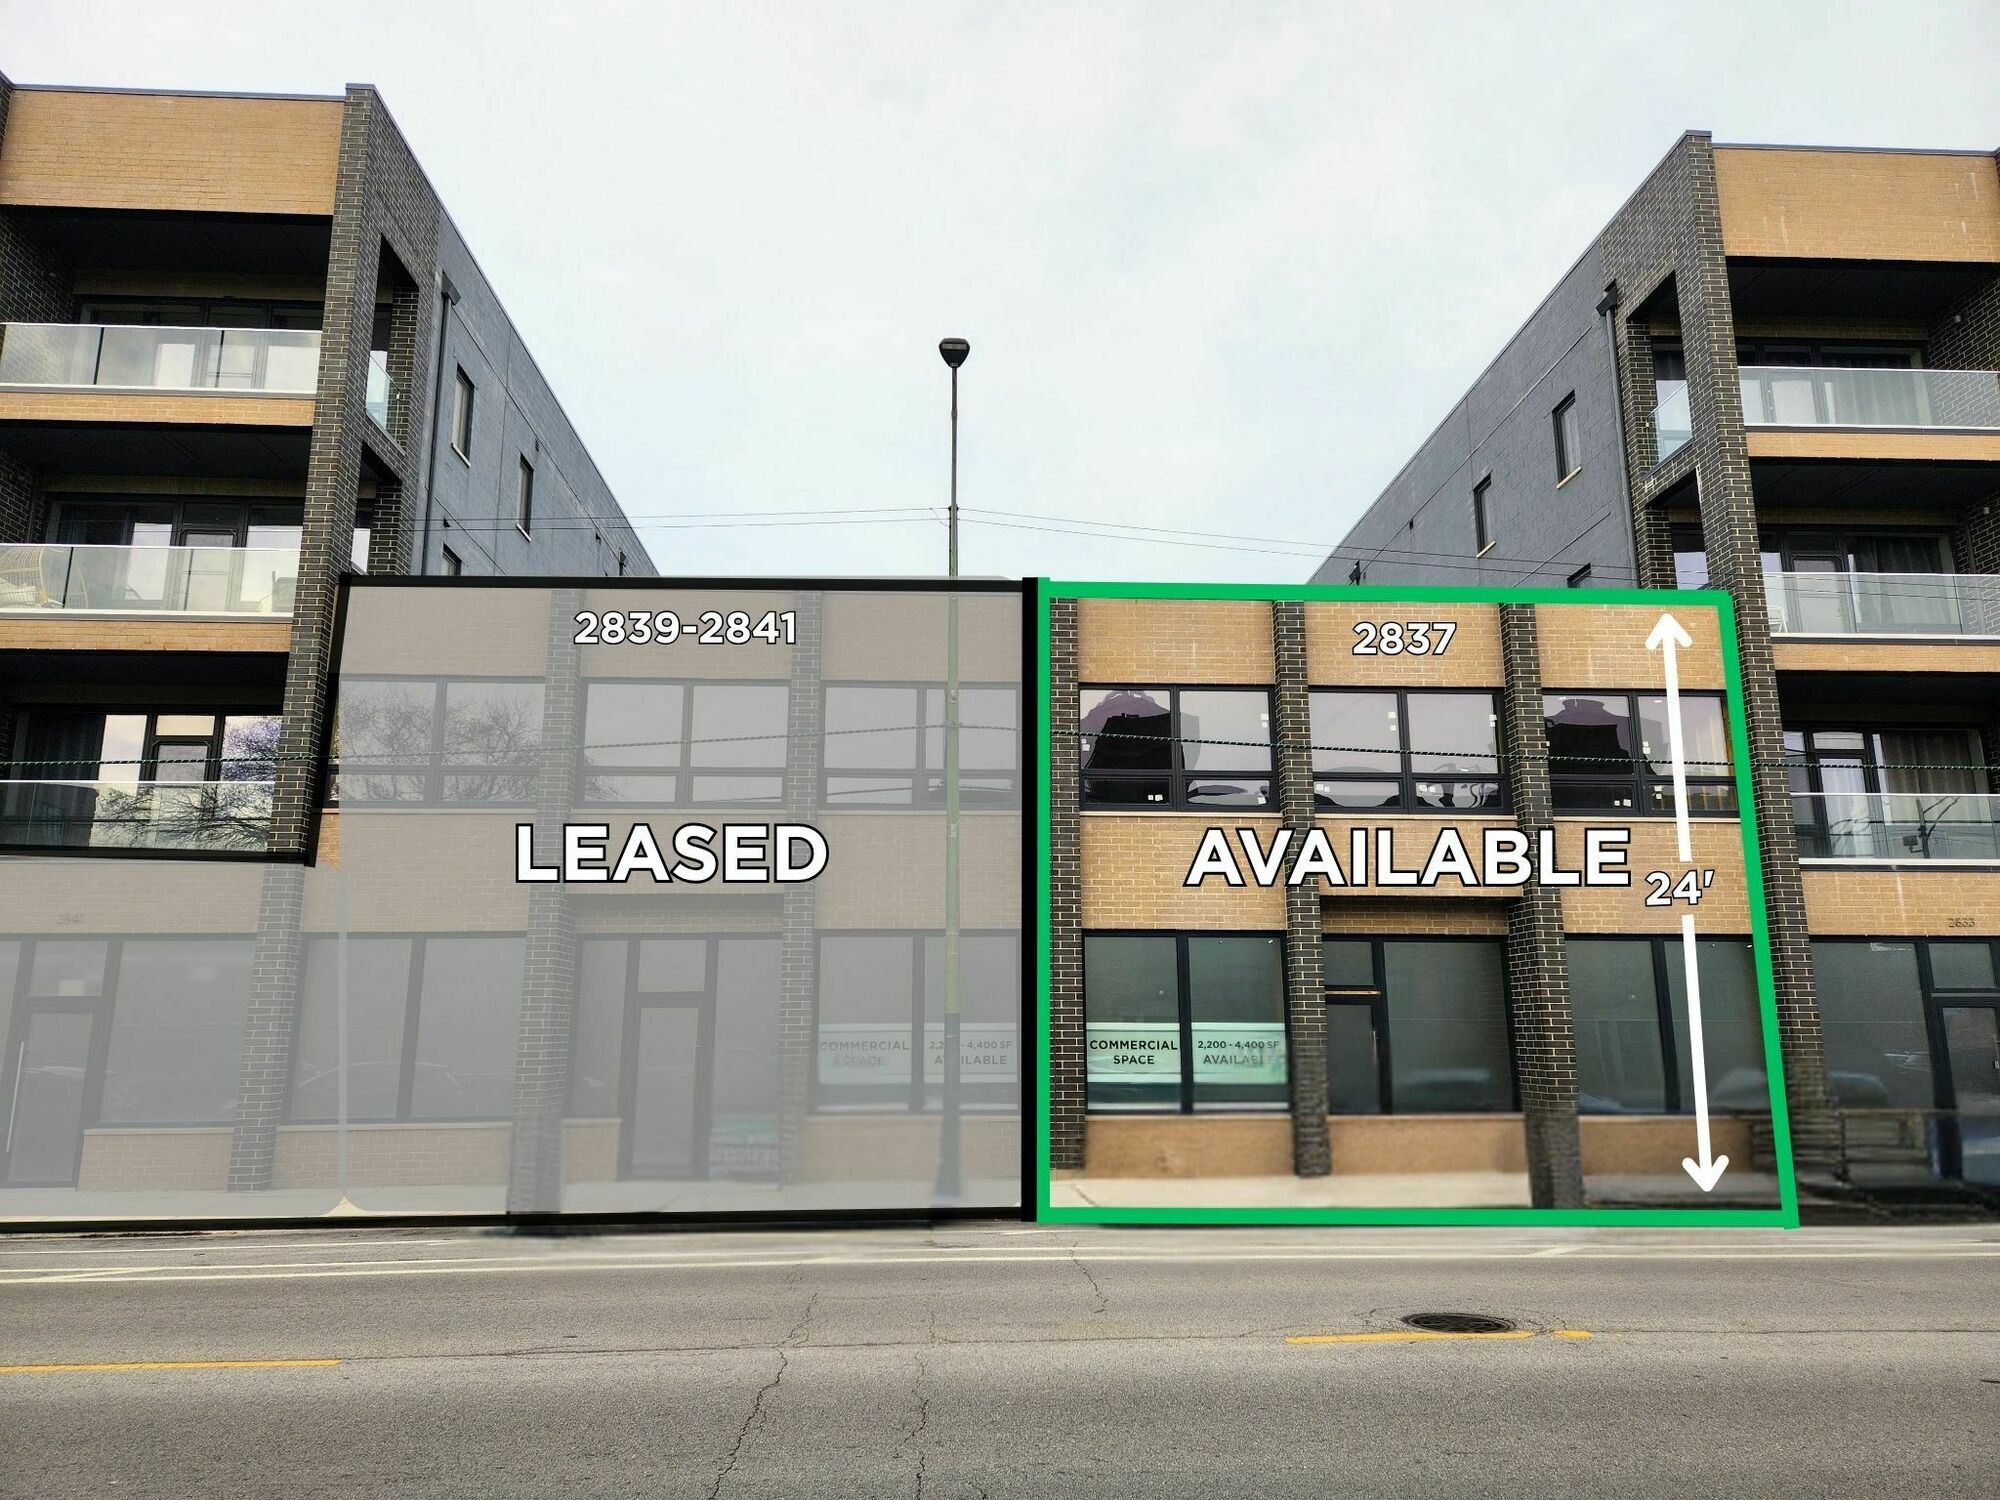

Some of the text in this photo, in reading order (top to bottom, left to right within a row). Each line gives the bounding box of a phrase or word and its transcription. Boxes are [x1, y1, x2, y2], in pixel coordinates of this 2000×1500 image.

[819, 1040, 910, 1051] COMMERCIAL
[967, 1041, 998, 1051] 4,400
[999, 1041, 1013, 1050] SF
[1089, 1040, 1178, 1050] COMMERCIAL
[1197, 1040, 1227, 1050] 2,200
[1234, 1041, 1265, 1051] 4,400
[1266, 1041, 1280, 1049] SF
[934, 1055, 1008, 1065] AILABLE
[1113, 1055, 1155, 1065] SPACE
